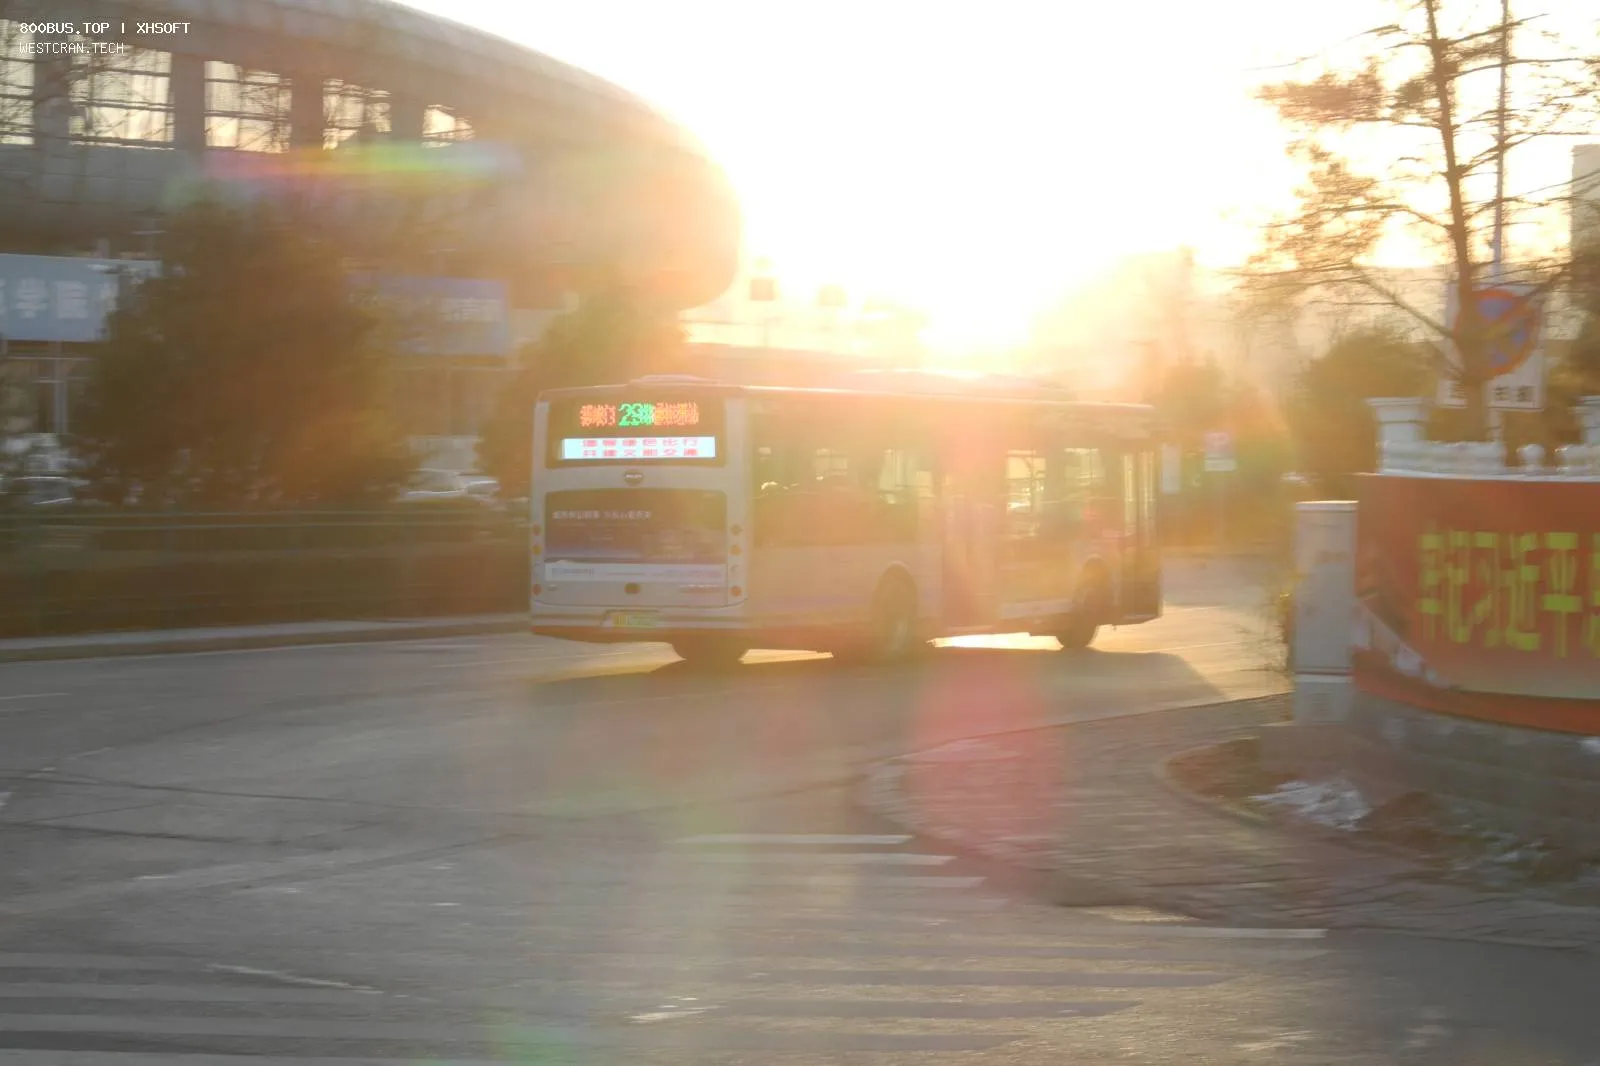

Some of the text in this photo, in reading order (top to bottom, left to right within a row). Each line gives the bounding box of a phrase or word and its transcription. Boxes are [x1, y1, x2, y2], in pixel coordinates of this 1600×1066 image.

[1417, 520, 1600, 657] 牢记习近平
